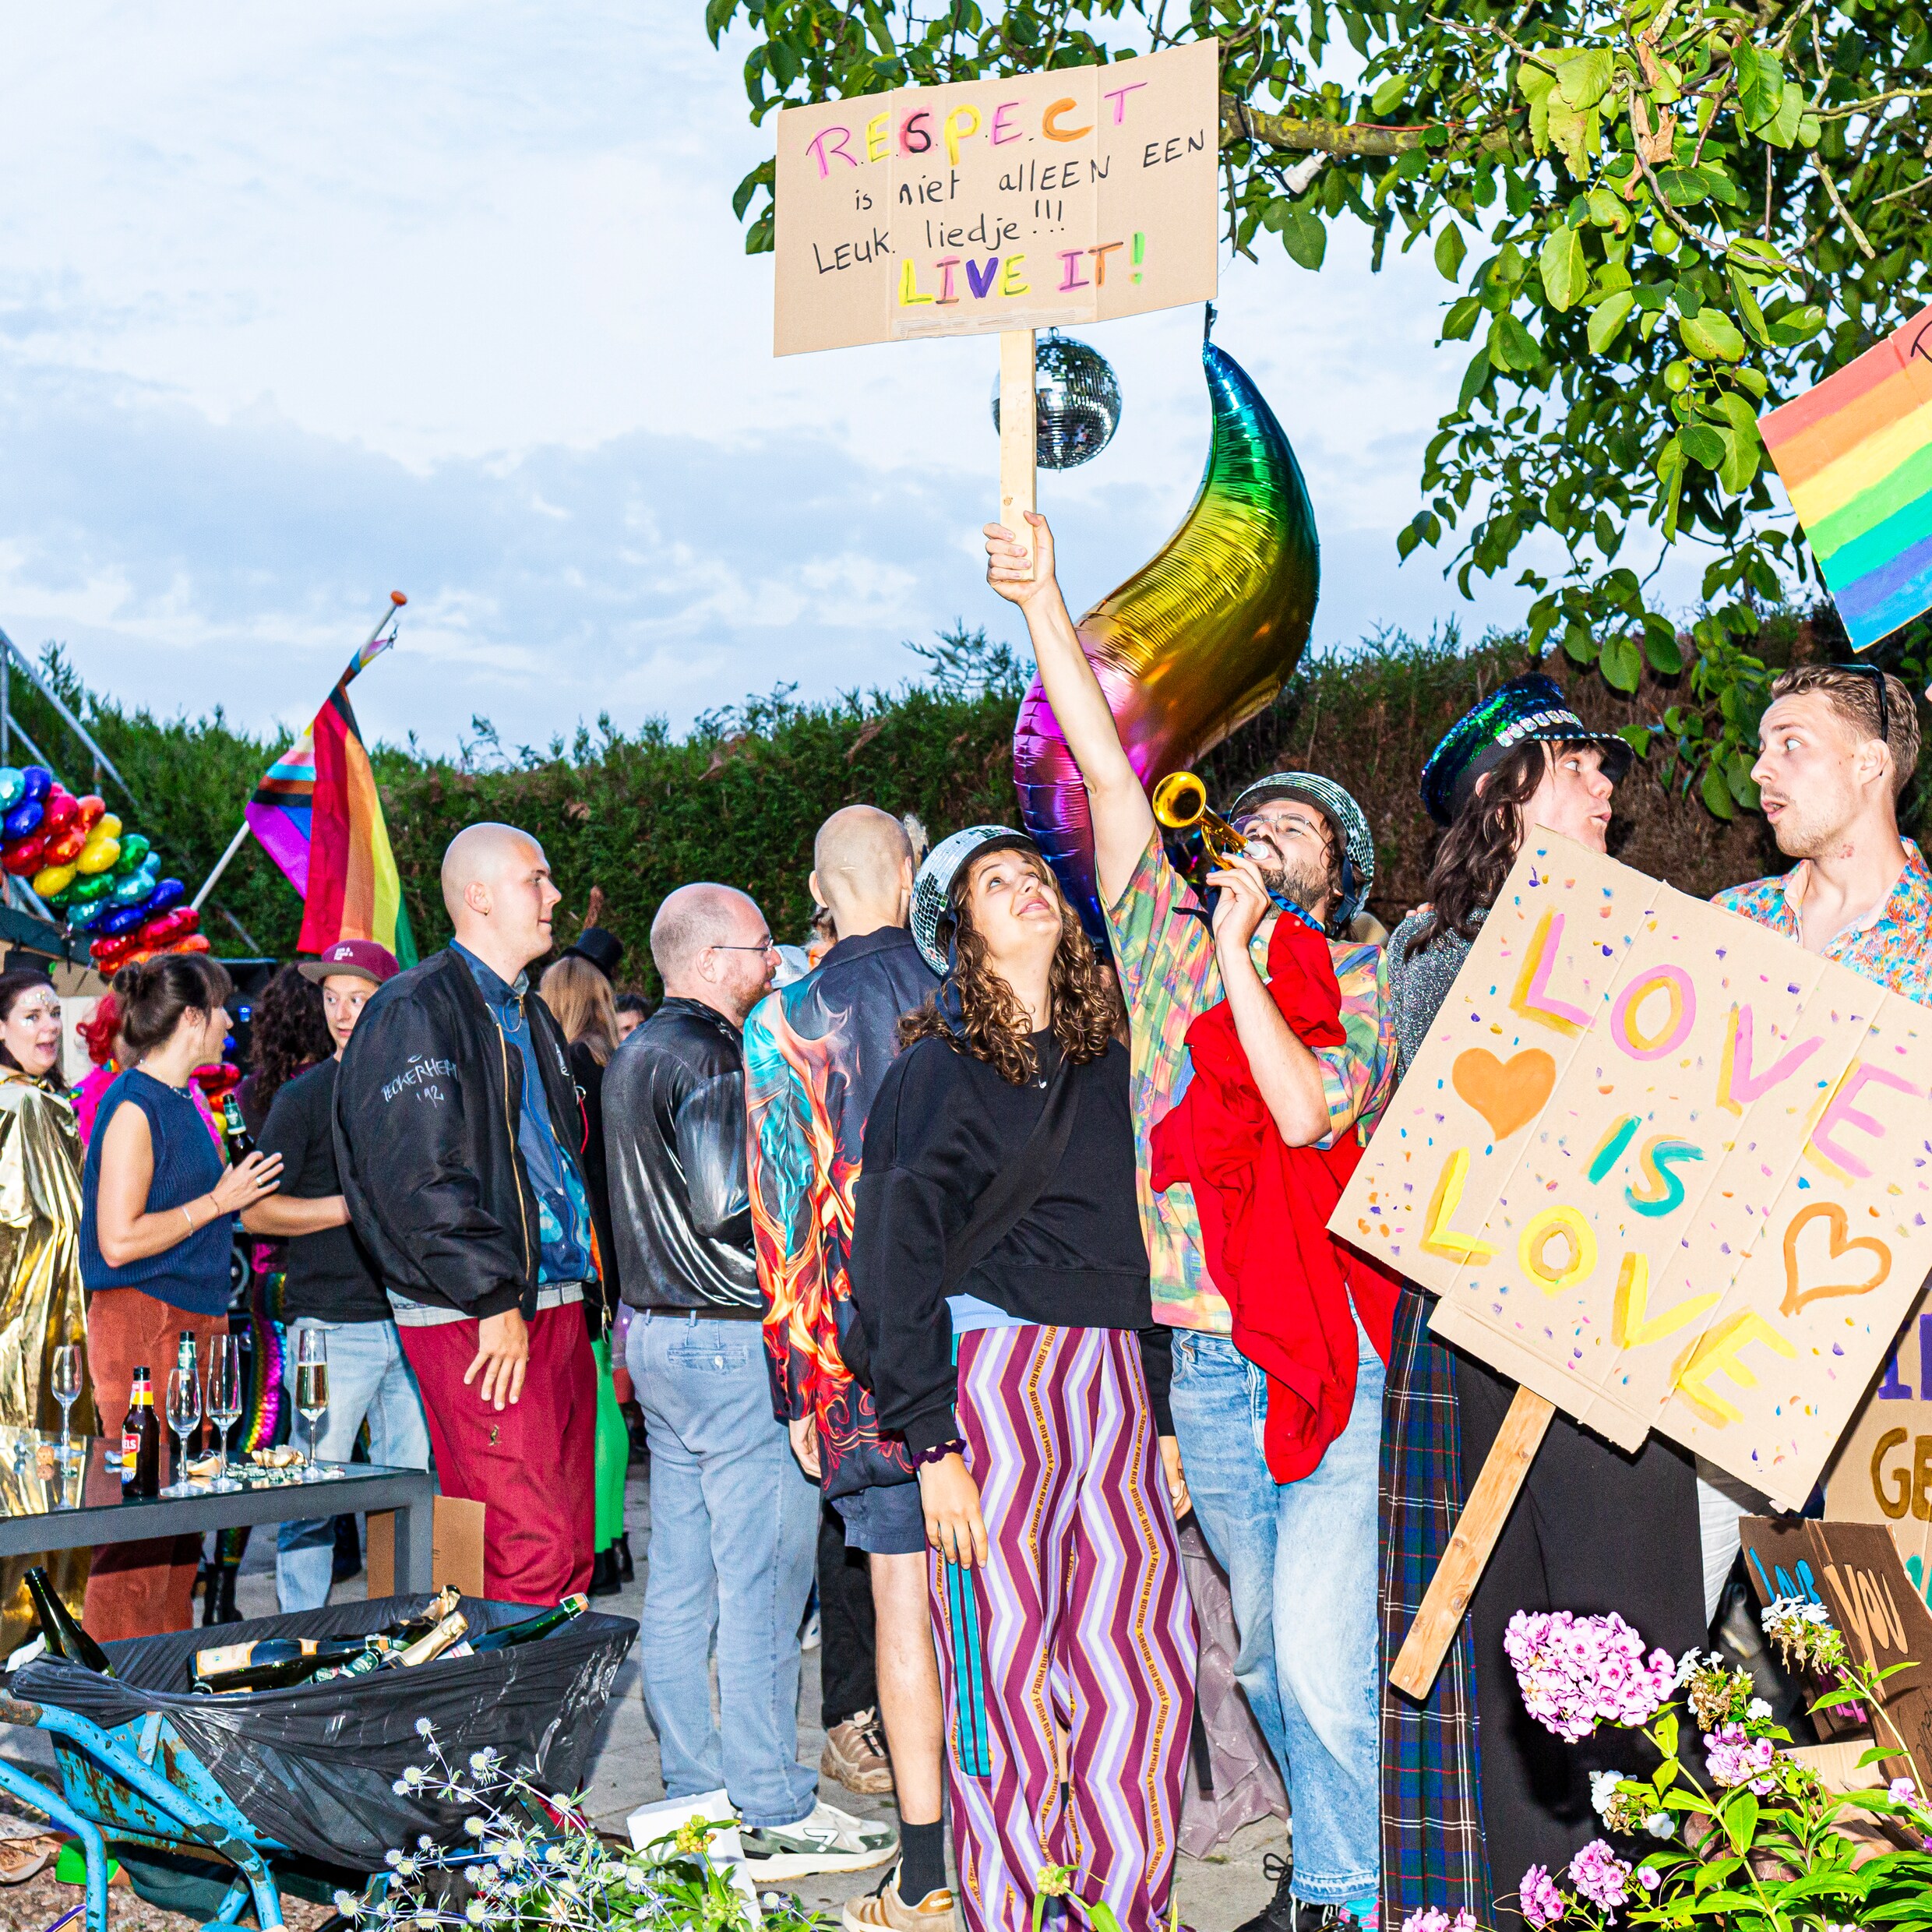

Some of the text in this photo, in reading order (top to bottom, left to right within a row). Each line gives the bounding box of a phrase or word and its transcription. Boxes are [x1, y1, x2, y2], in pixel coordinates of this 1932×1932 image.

[855, 189, 873, 210] is
[899, 170, 961, 205] niet
[1142, 129, 1205, 168] EEN
[898, 253, 1031, 308] LIVE
[1510, 904, 1926, 1188] LOVE
[1581, 1112, 1705, 1218] IS
[1419, 1146, 1799, 1430] LOVE
[1029, 1391, 1044, 1422] ADIDAS
[1130, 1487, 1146, 1517] ADIDAS
[1137, 1599, 1148, 1629] ADIDAS
[1137, 1633, 1152, 1662] ADIDAS
[1156, 1704, 1169, 1736] ADIDAS
[1155, 1818, 1165, 1847] ADIDAS
